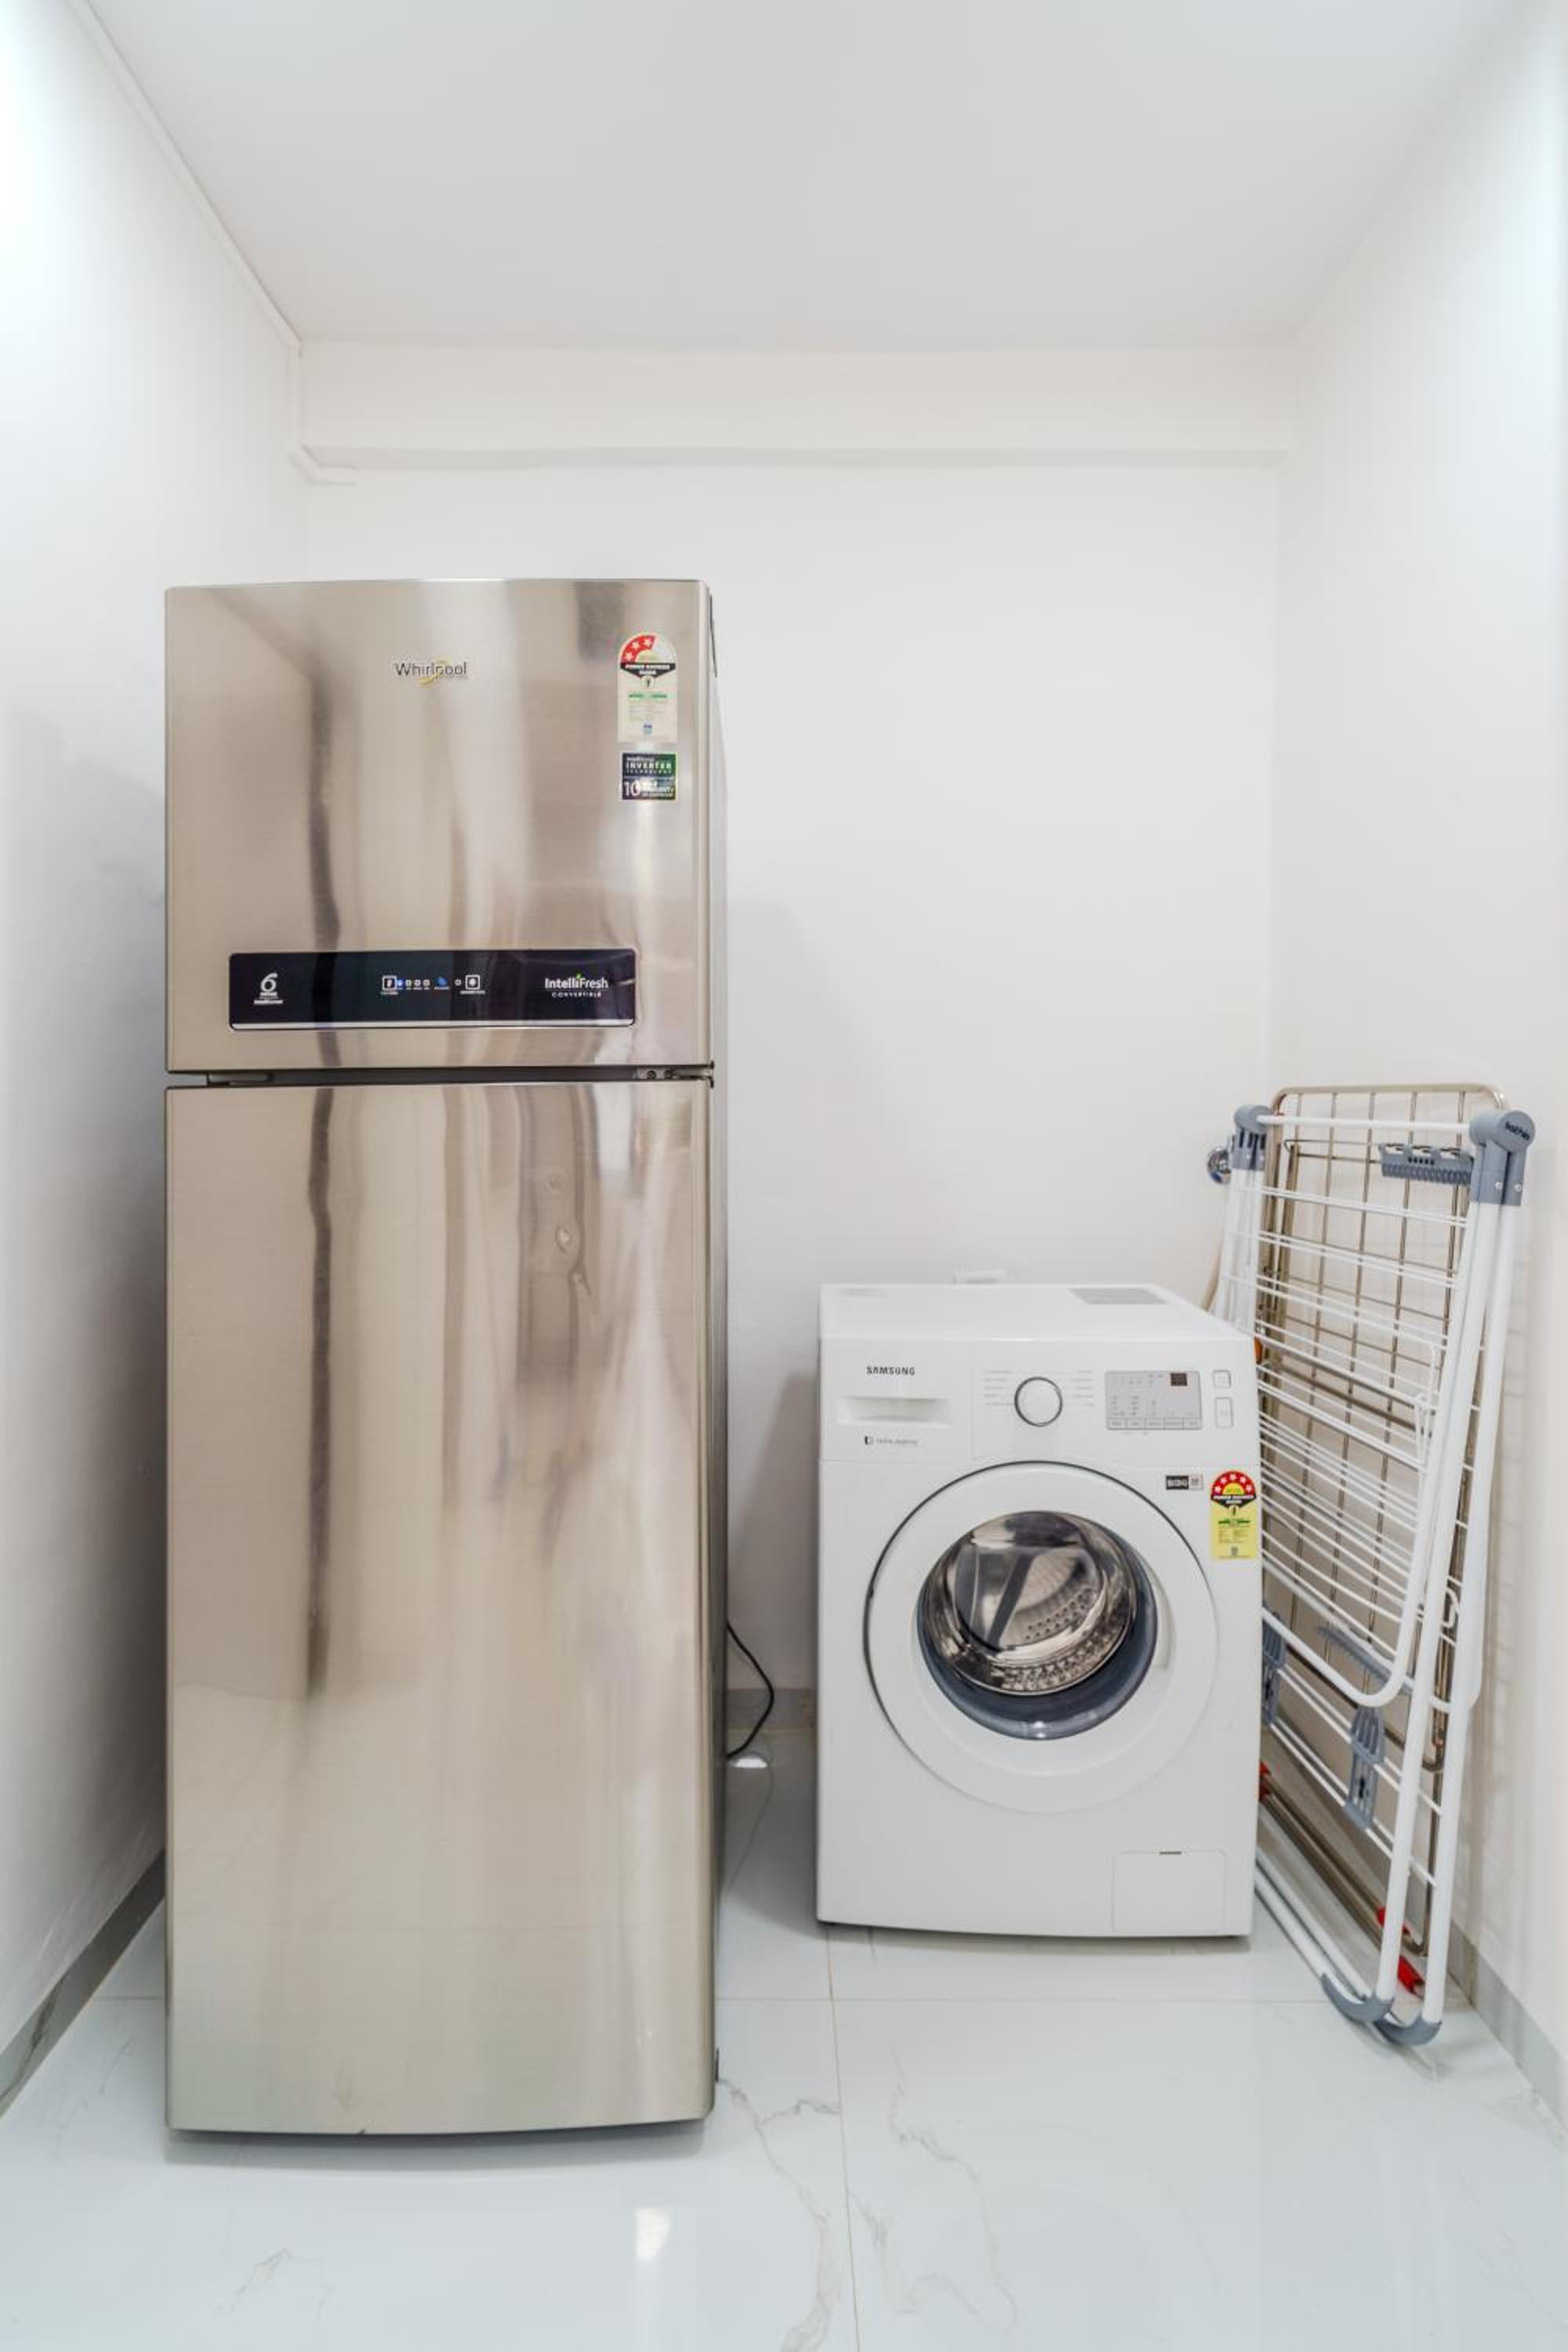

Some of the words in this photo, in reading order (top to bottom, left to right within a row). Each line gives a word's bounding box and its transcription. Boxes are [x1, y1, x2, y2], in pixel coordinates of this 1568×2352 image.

[394, 661, 466, 680] Whirlpool
[260, 973, 278, 992] 6
[545, 975, 609, 989] IntelliFresh
[866, 1367, 916, 1375] SAMSUNG
